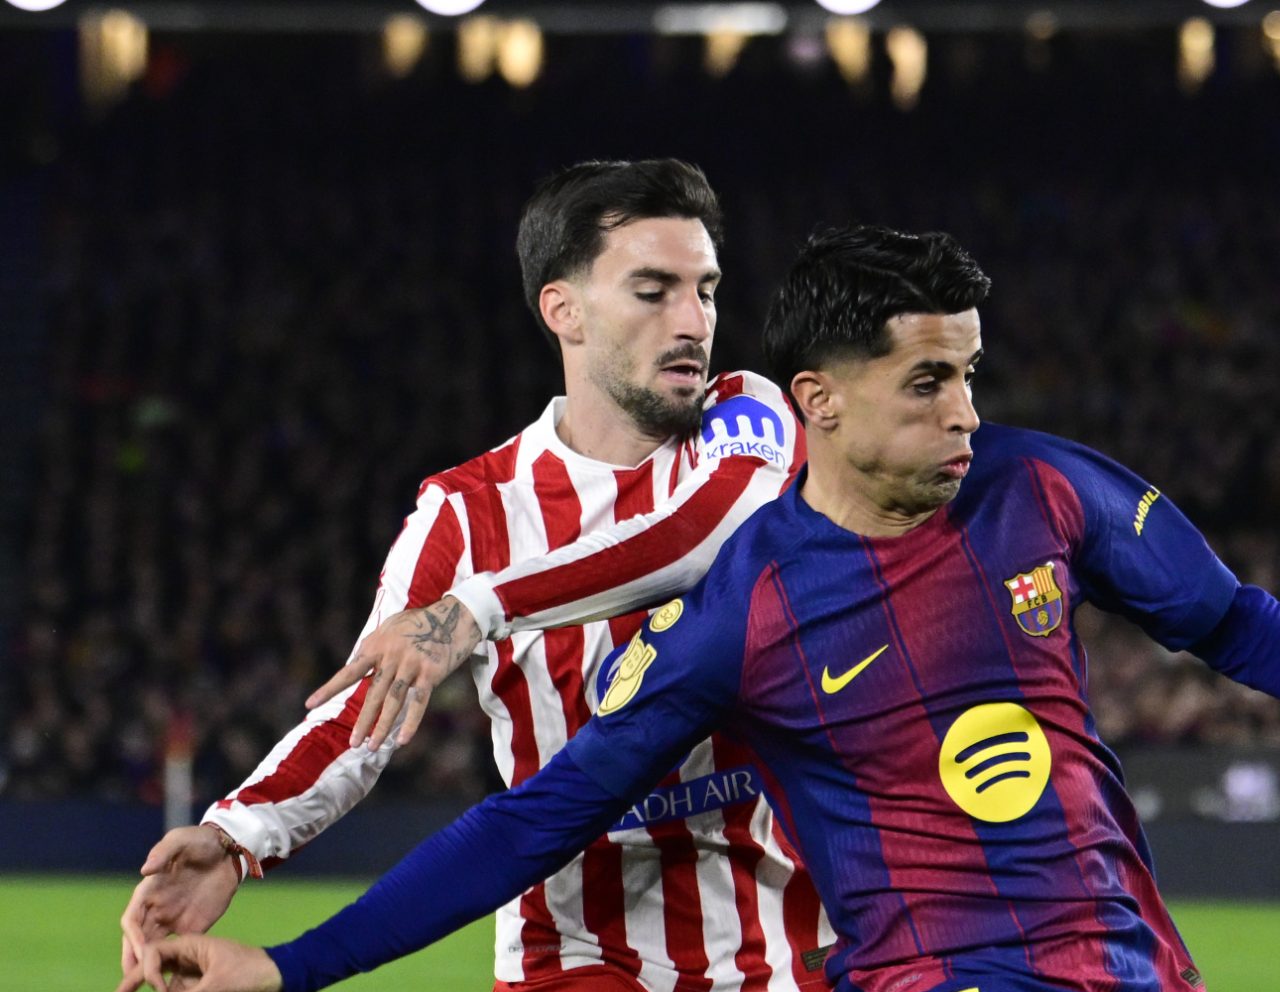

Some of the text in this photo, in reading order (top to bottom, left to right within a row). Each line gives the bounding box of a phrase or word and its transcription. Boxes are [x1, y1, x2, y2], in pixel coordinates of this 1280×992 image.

[706, 441, 786, 470] kraken
[1133, 485, 1161, 537] AMBIL
[1027, 594, 1048, 609] FCB
[703, 770, 756, 809] AIR
